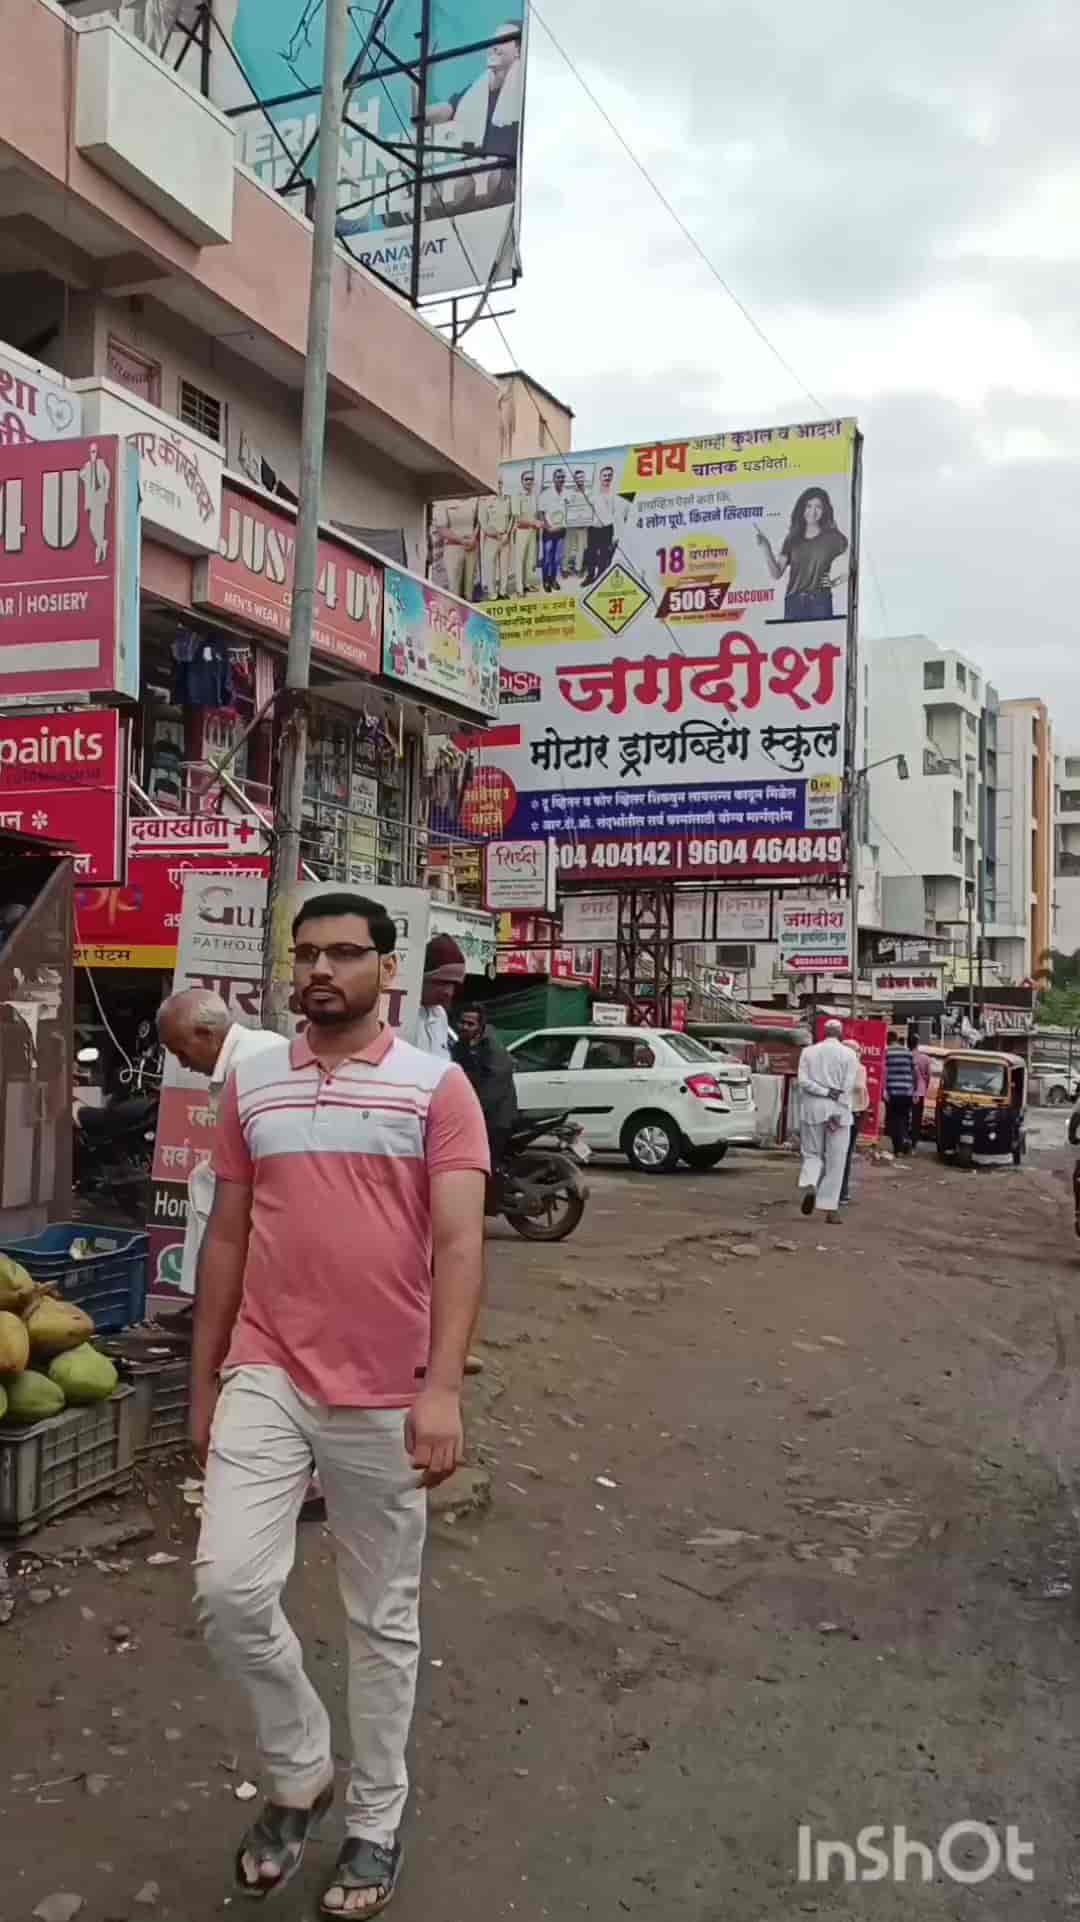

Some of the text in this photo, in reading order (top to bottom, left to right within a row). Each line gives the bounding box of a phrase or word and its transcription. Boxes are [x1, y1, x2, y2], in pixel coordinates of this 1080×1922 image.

[730, 428, 773, 451] कुशल
[692, 460, 740, 477] चालक
[42, 470, 80, 549] U
[656, 545, 685, 574] 18
[27, 591, 88, 614] HOSIERY
[317, 560, 337, 609] 4
[345, 568, 365, 622] U
[727, 588, 775, 604] DISCOUNT
[556, 631, 841, 714] जगदीश
[0, 725, 103, 775] paints
[530, 717, 841, 778] मोटार ड्रायव्हिंग स्कुल
[131, 818, 229, 840] दवाखाना
[591, 841, 672, 869] 404142
[688, 839, 747, 865] 9604
[752, 836, 842, 863] 464849
[783, 908, 844, 929] जगदीश
